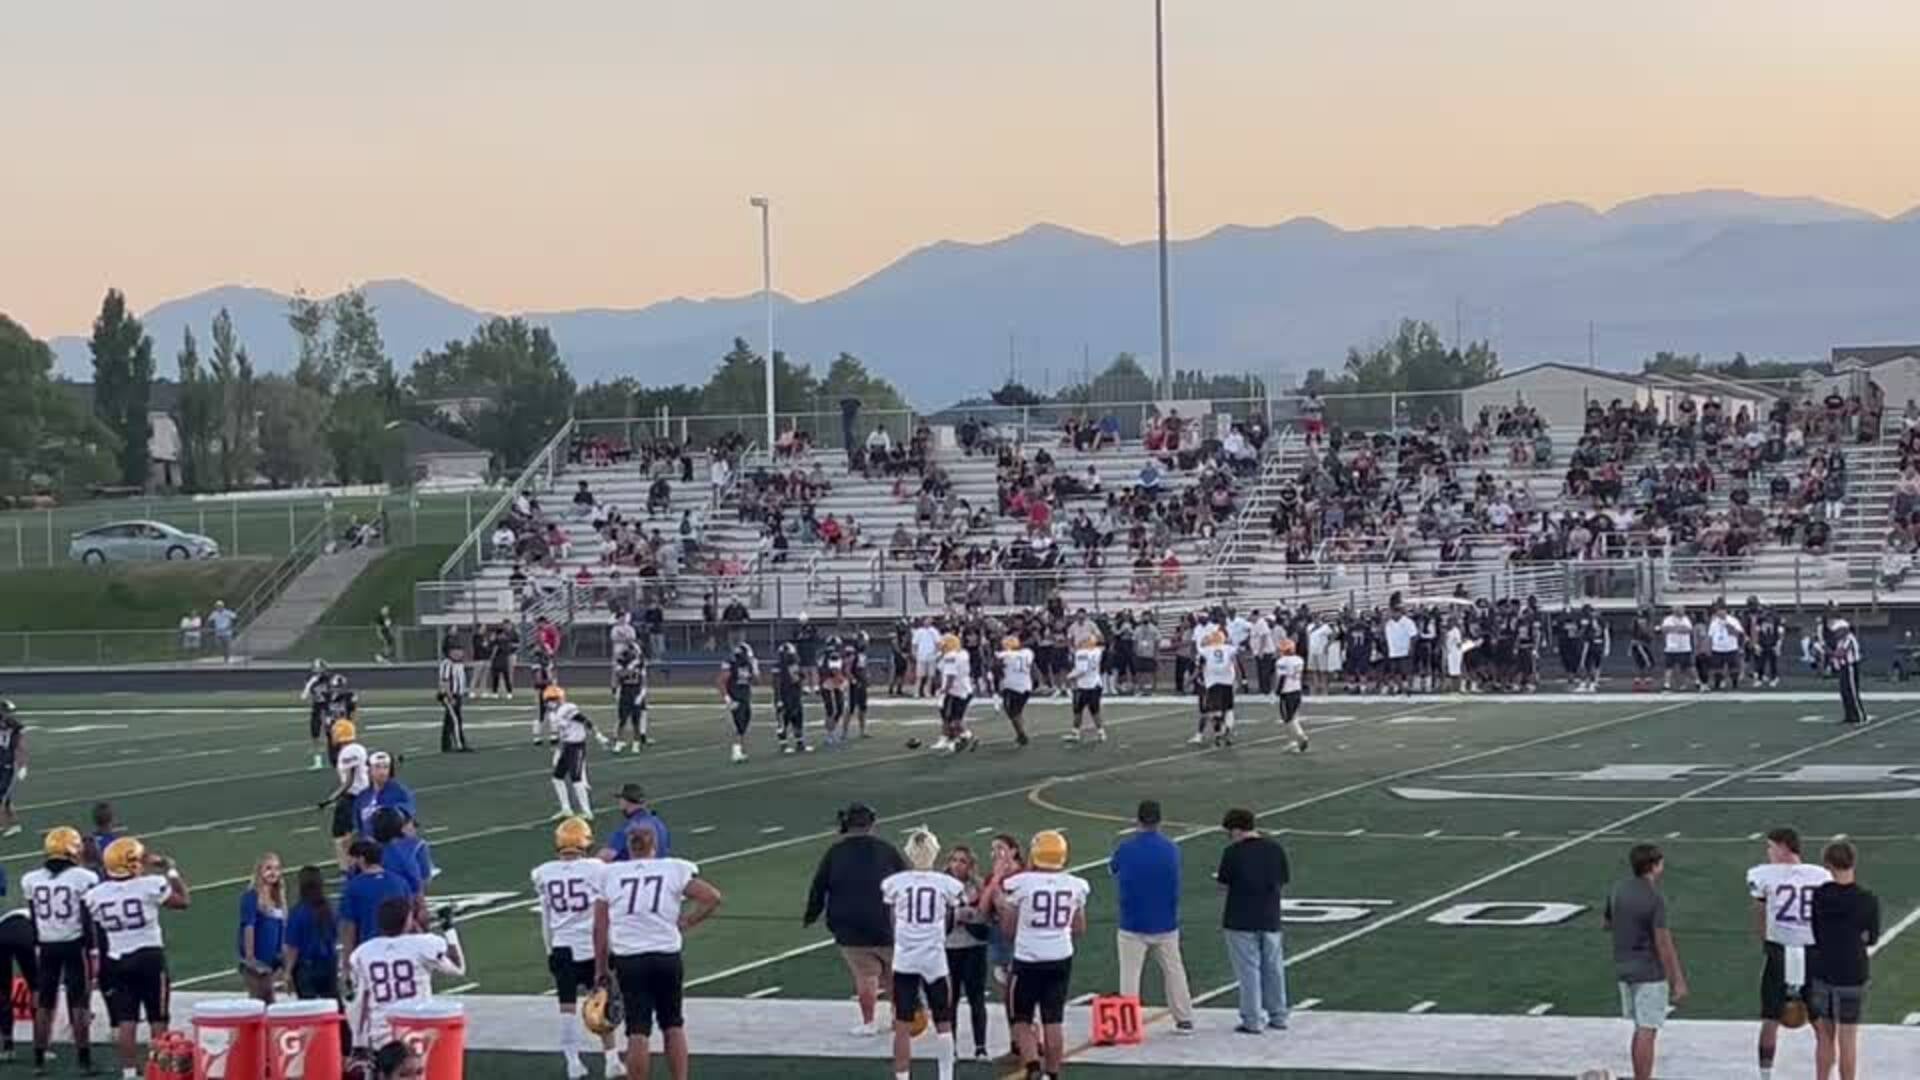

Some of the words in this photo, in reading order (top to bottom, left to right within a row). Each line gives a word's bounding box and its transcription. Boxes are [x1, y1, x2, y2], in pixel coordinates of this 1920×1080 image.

[33, 885, 73, 920] 83
[547, 878, 589, 913] 85
[620, 875, 664, 915] 77
[905, 885, 936, 924] 10
[1031, 889, 1073, 928] 96
[100, 897, 146, 932] 59
[369, 959, 417, 1003] 88
[1099, 1002, 1139, 1039] 50
[280, 1030, 301, 1056] G
